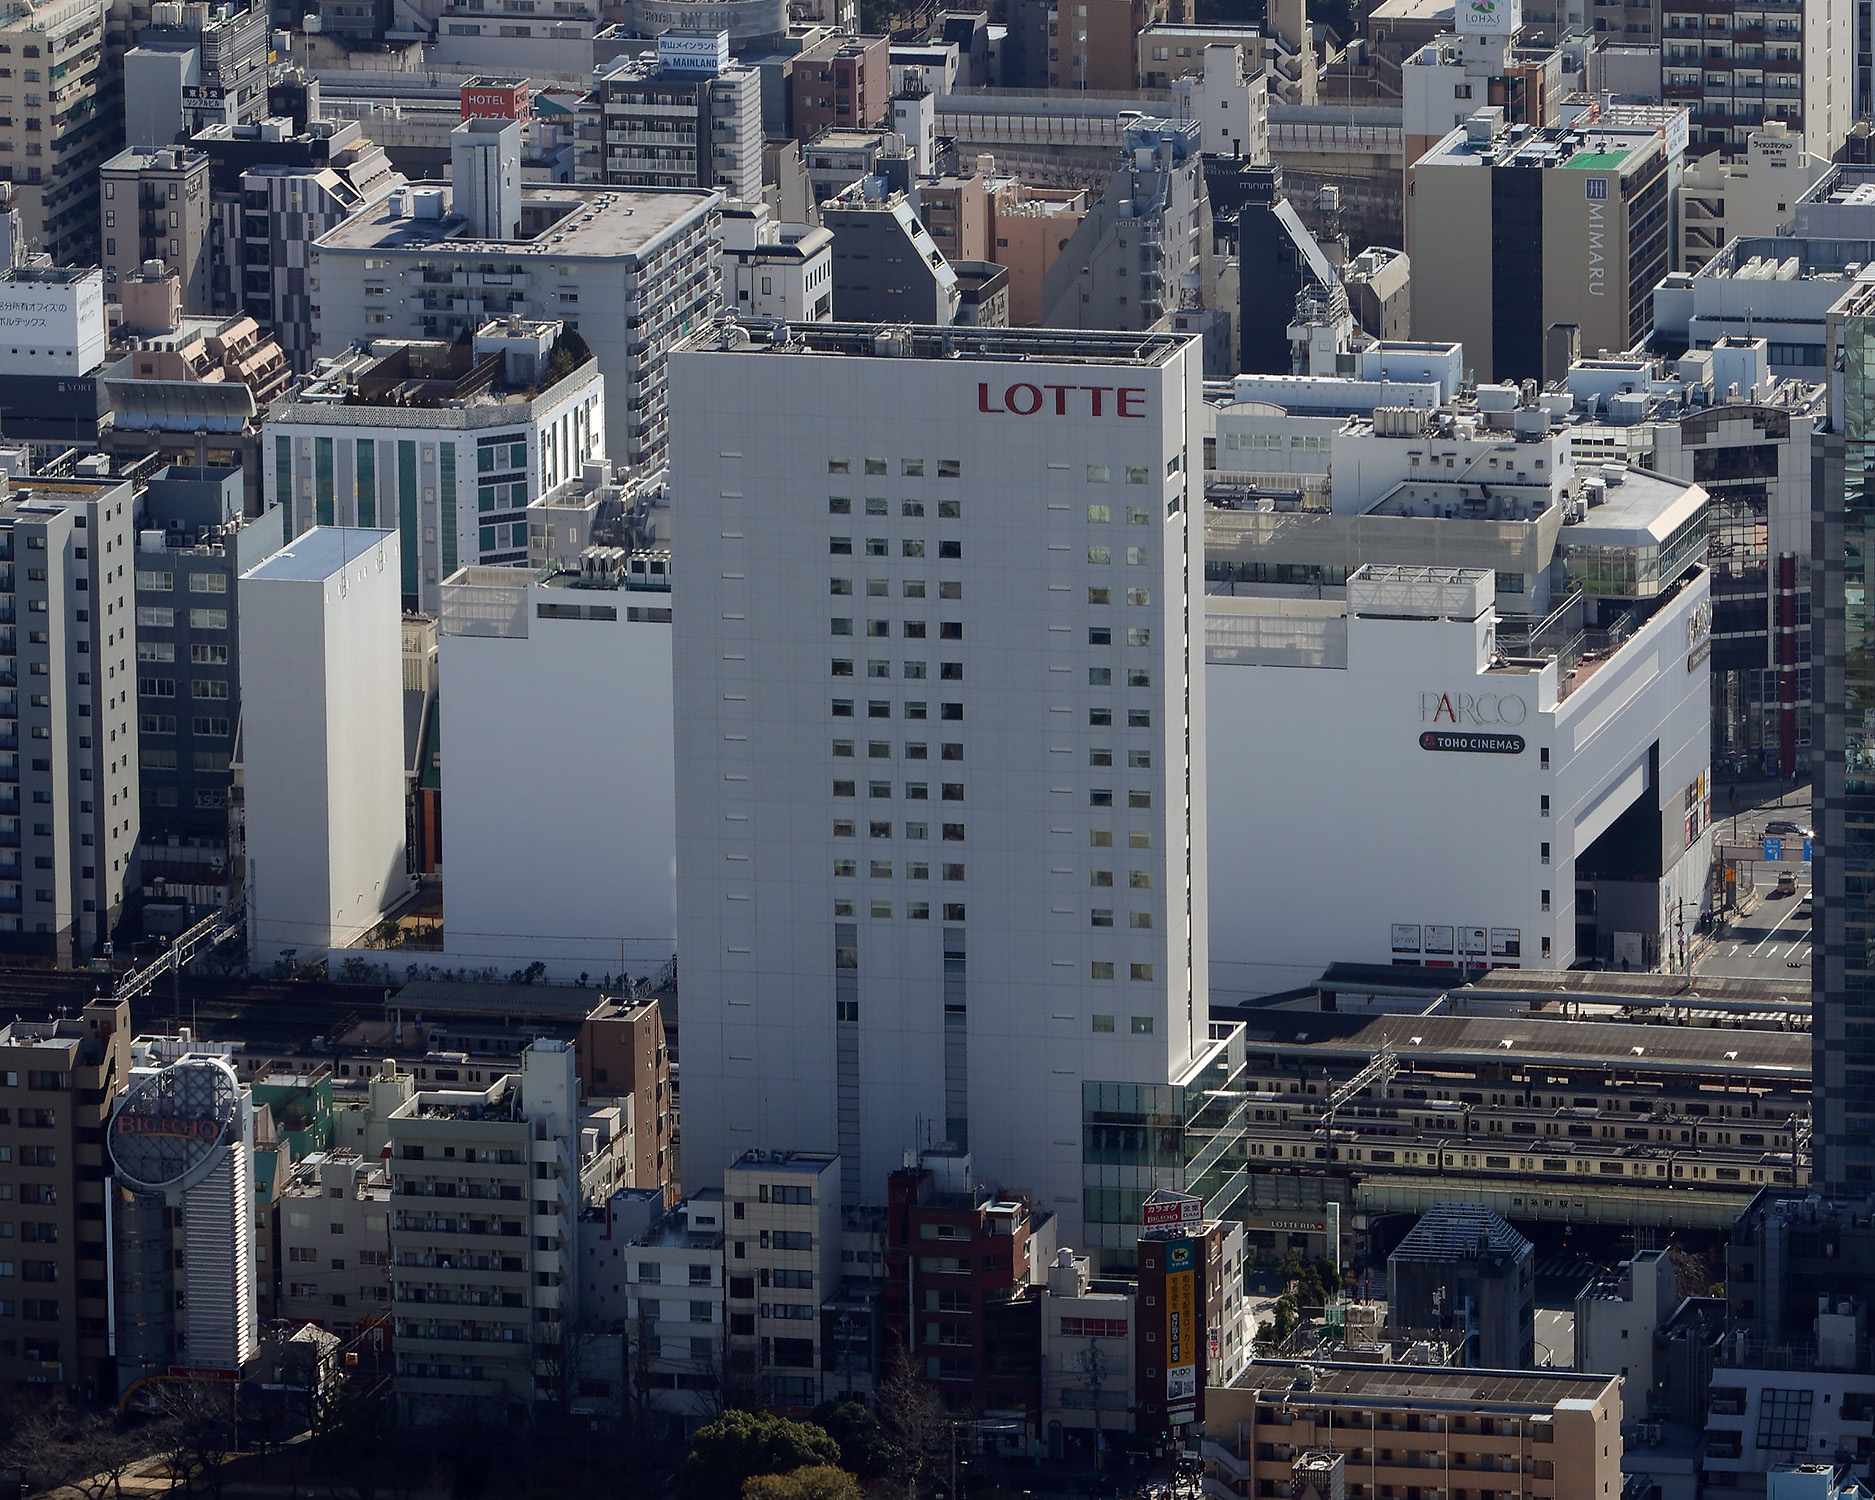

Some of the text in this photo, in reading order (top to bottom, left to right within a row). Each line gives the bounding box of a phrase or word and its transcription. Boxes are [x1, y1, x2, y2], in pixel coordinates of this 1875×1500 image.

[645, 11, 675, 24] HOTEL
[680, 12, 701, 28] RAY
[1465, 14, 1501, 24] LOHAS
[660, 41, 717, 51] 青山メインランド
[673, 57, 717, 68] MAINLAND
[468, 95, 506, 105] HOTEL
[1753, 141, 1793, 149] ライオンズマンション
[1589, 202, 1604, 296] MIMARU
[978, 383, 1146, 418] LOTTE
[1419, 691, 1527, 727] PARCO
[1437, 737, 1520, 750] TOHO CINEMAS
[1147, 1202, 1178, 1214] カラオケ
[1271, 1221, 1316, 1230] LOTTERIA
[1171, 1368, 1190, 1377] PUDO
